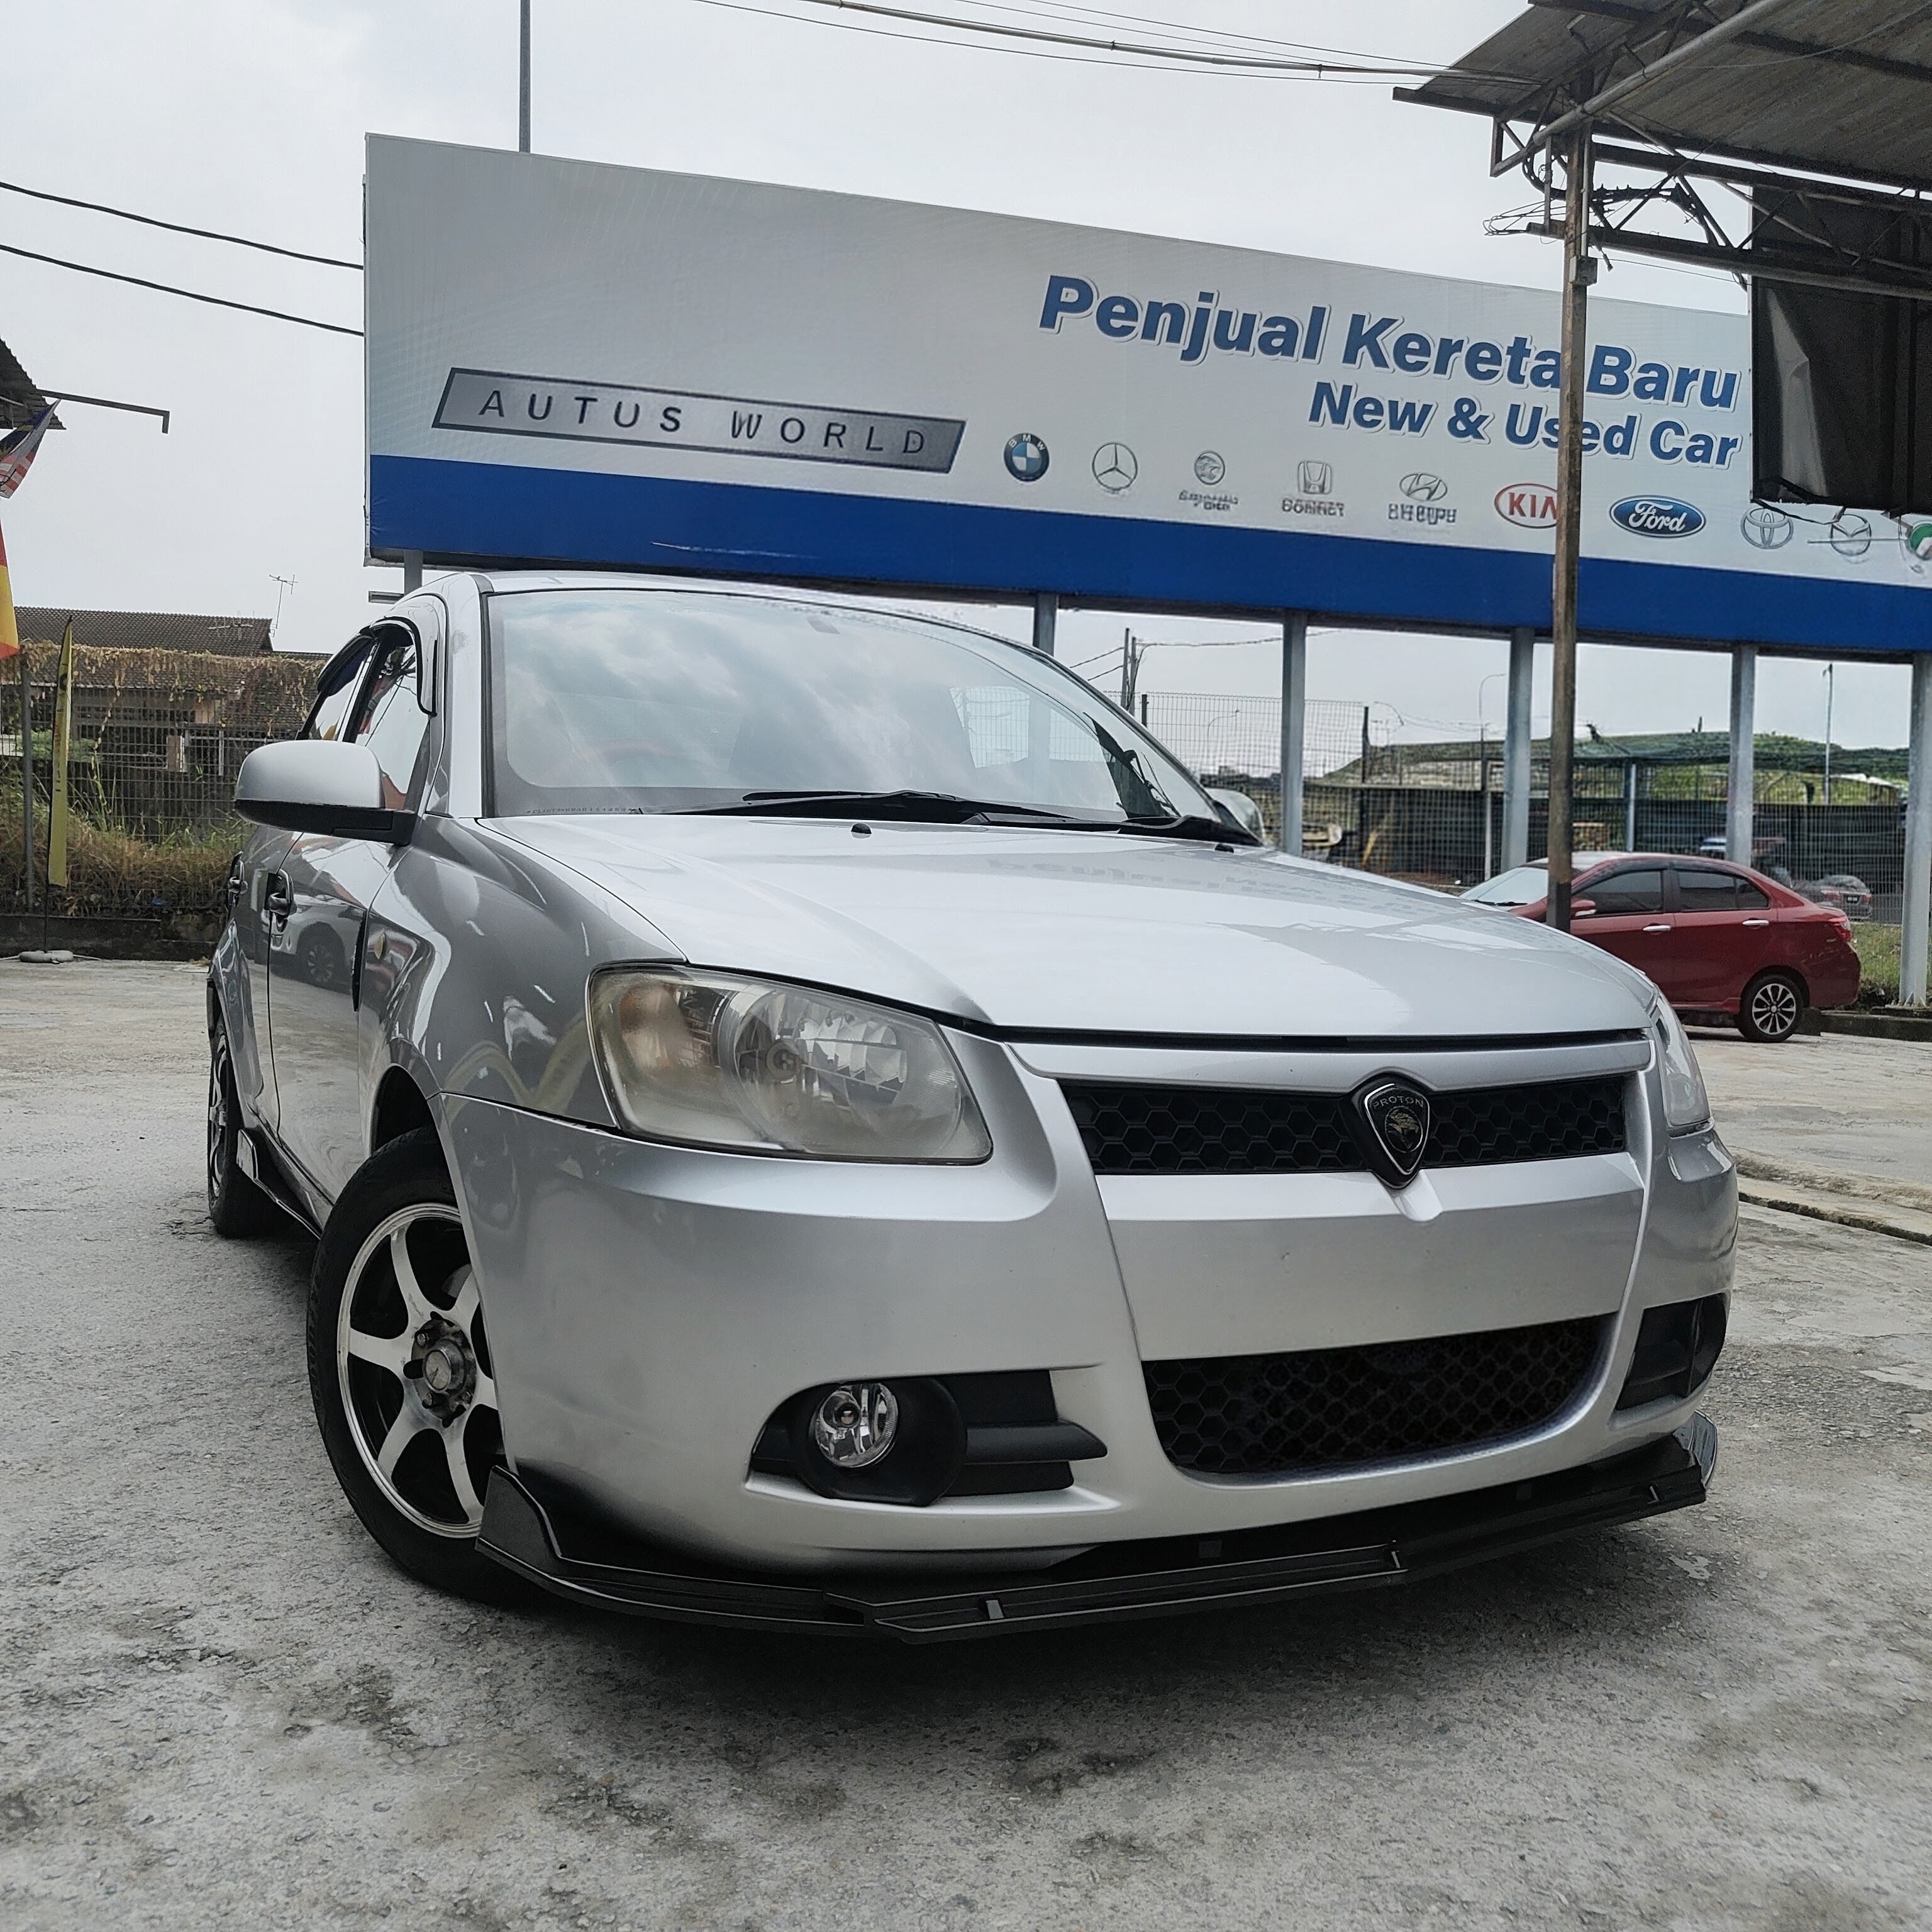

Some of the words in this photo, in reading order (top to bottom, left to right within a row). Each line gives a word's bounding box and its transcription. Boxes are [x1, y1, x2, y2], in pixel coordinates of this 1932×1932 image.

[1039, 274, 1327, 363] Penjual
[1341, 313, 1562, 389] Kereta
[1585, 344, 1738, 409] Baru
[478, 389, 682, 433] AUTUS
[730, 410, 926, 454] WORLD
[1308, 381, 1435, 434] New
[1446, 396, 1490, 441] &
[1505, 402, 1638, 457] Used
[1649, 419, 1740, 466] Car
[1008, 434, 1046, 452] BMW
[1508, 492, 1558, 520] KIA
[1628, 501, 1686, 533] Ford
[1373, 1095, 1424, 1109] PROTON
